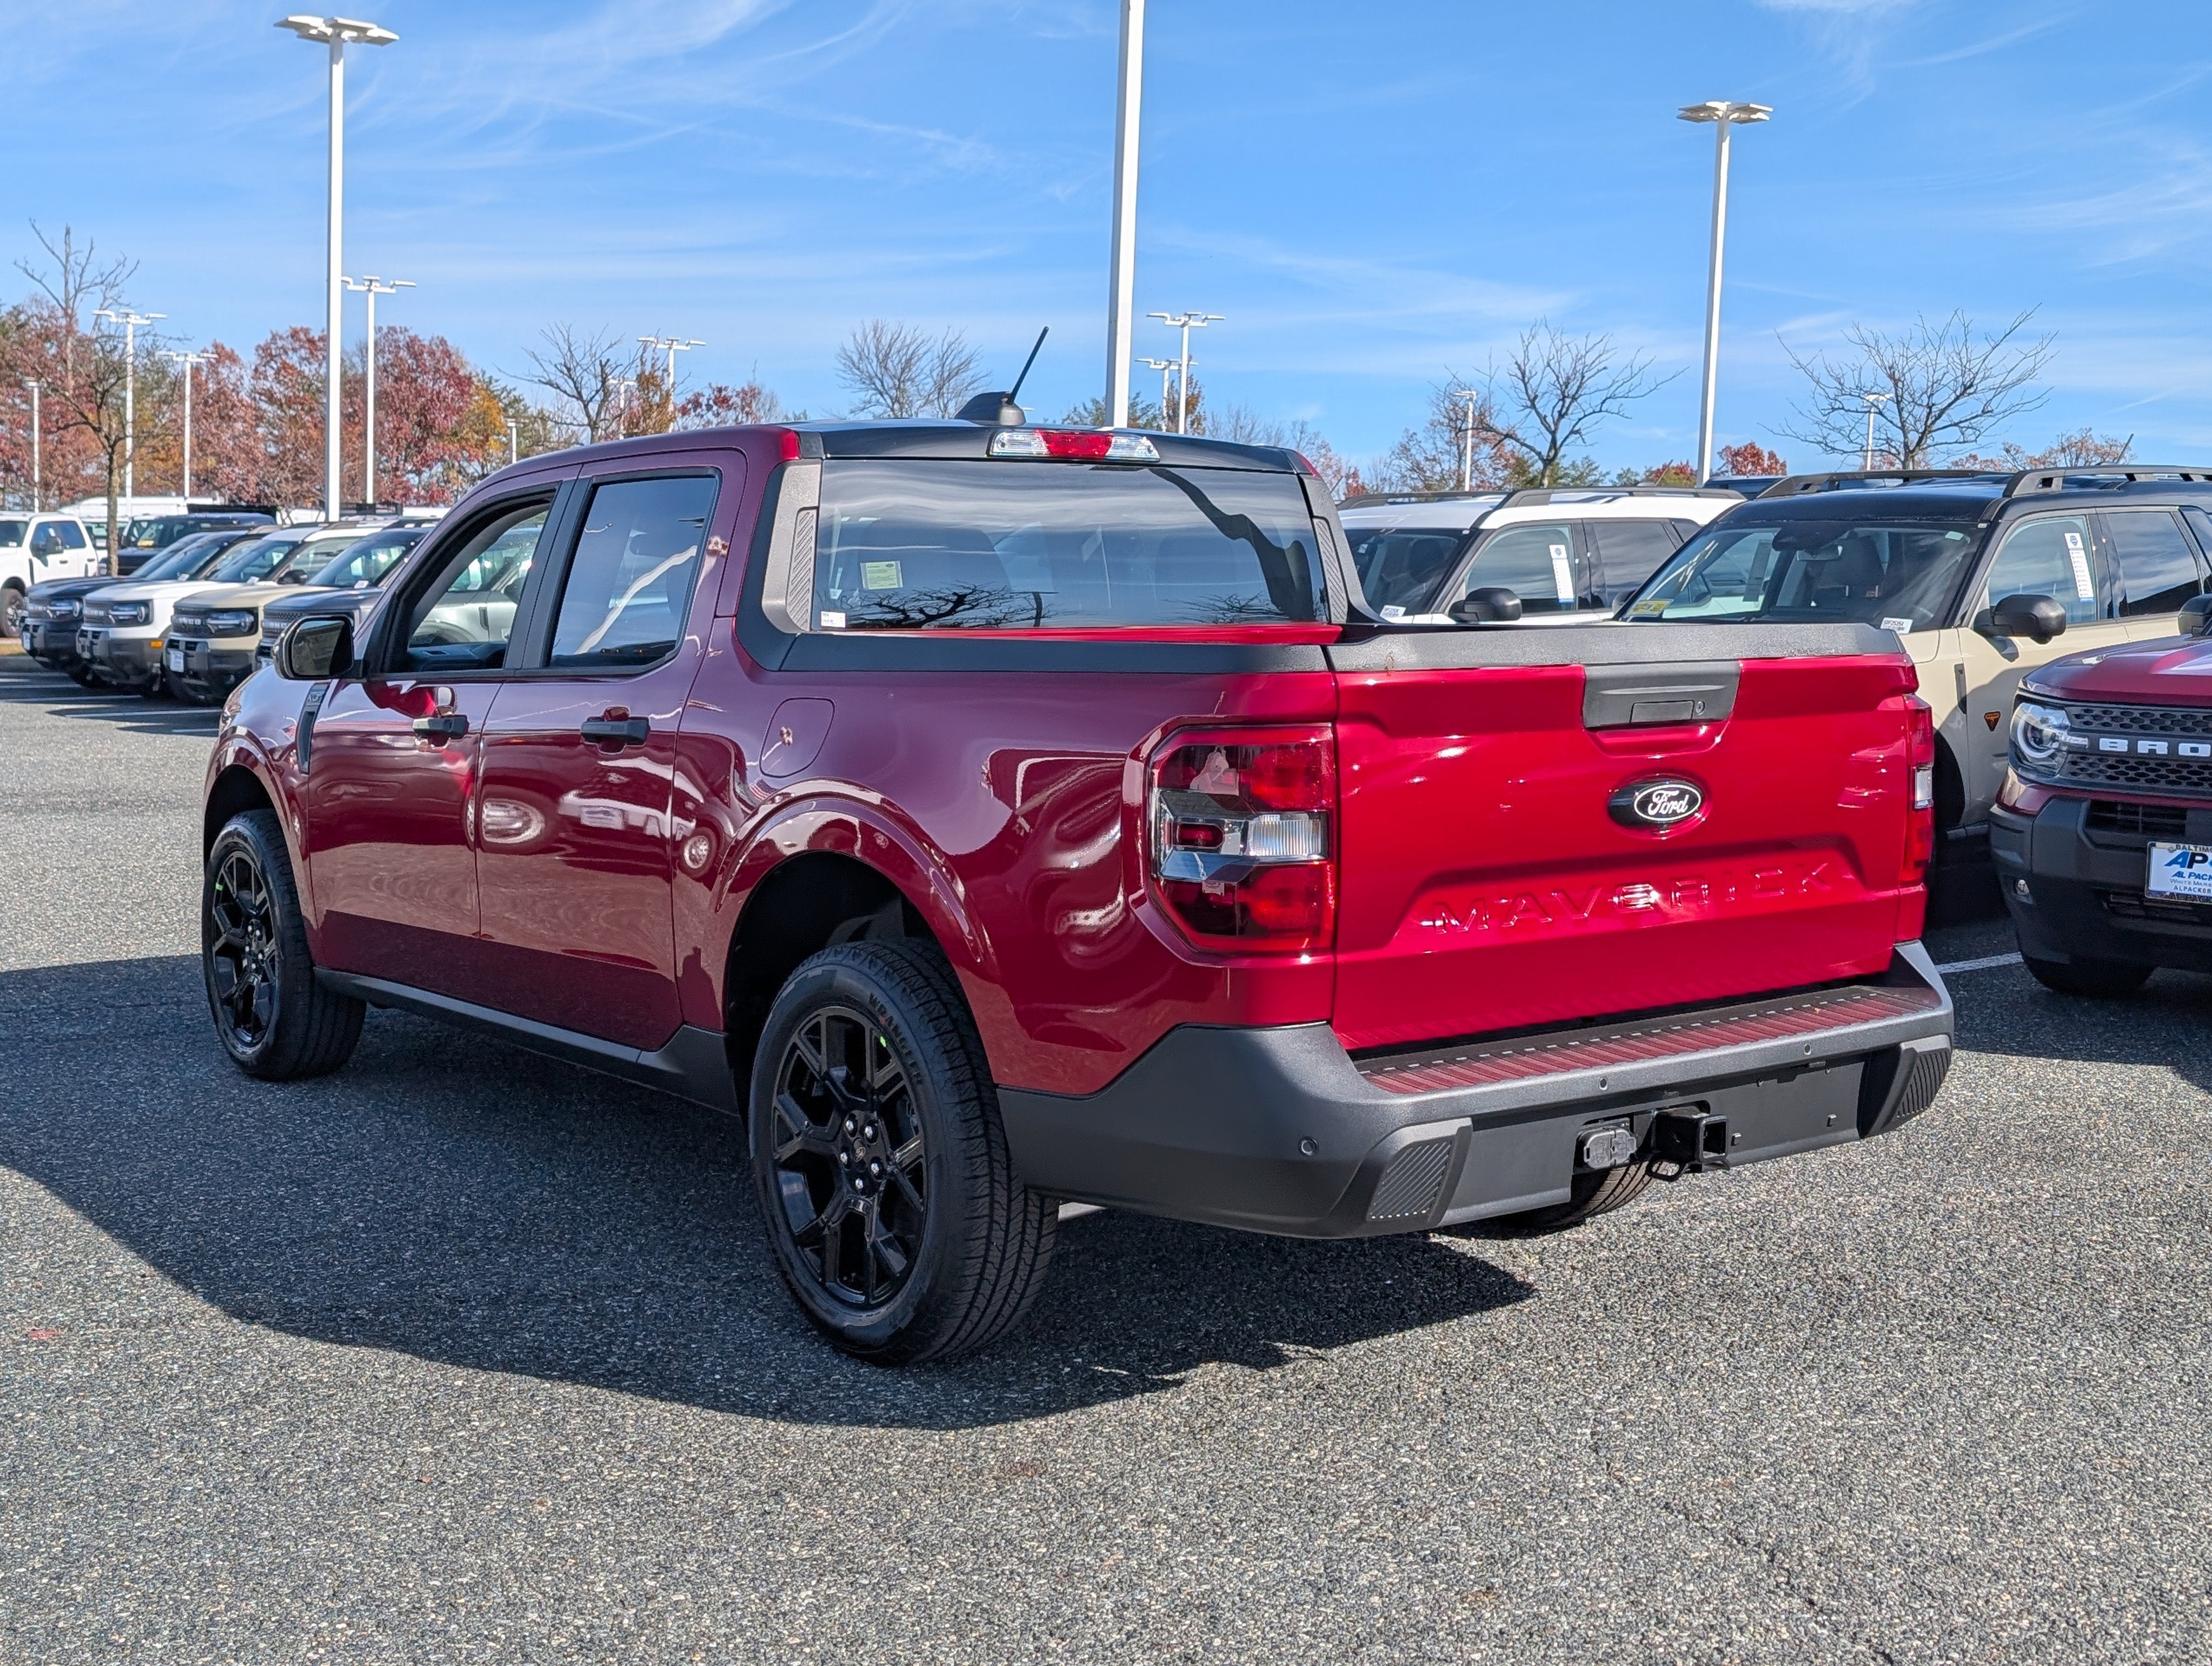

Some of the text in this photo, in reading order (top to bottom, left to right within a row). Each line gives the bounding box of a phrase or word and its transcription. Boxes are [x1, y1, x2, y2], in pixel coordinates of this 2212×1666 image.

[1648, 790, 1689, 815] Ford
[1433, 863, 1832, 934] MAVERICK
[869, 992, 923, 1085] WRANGLER
